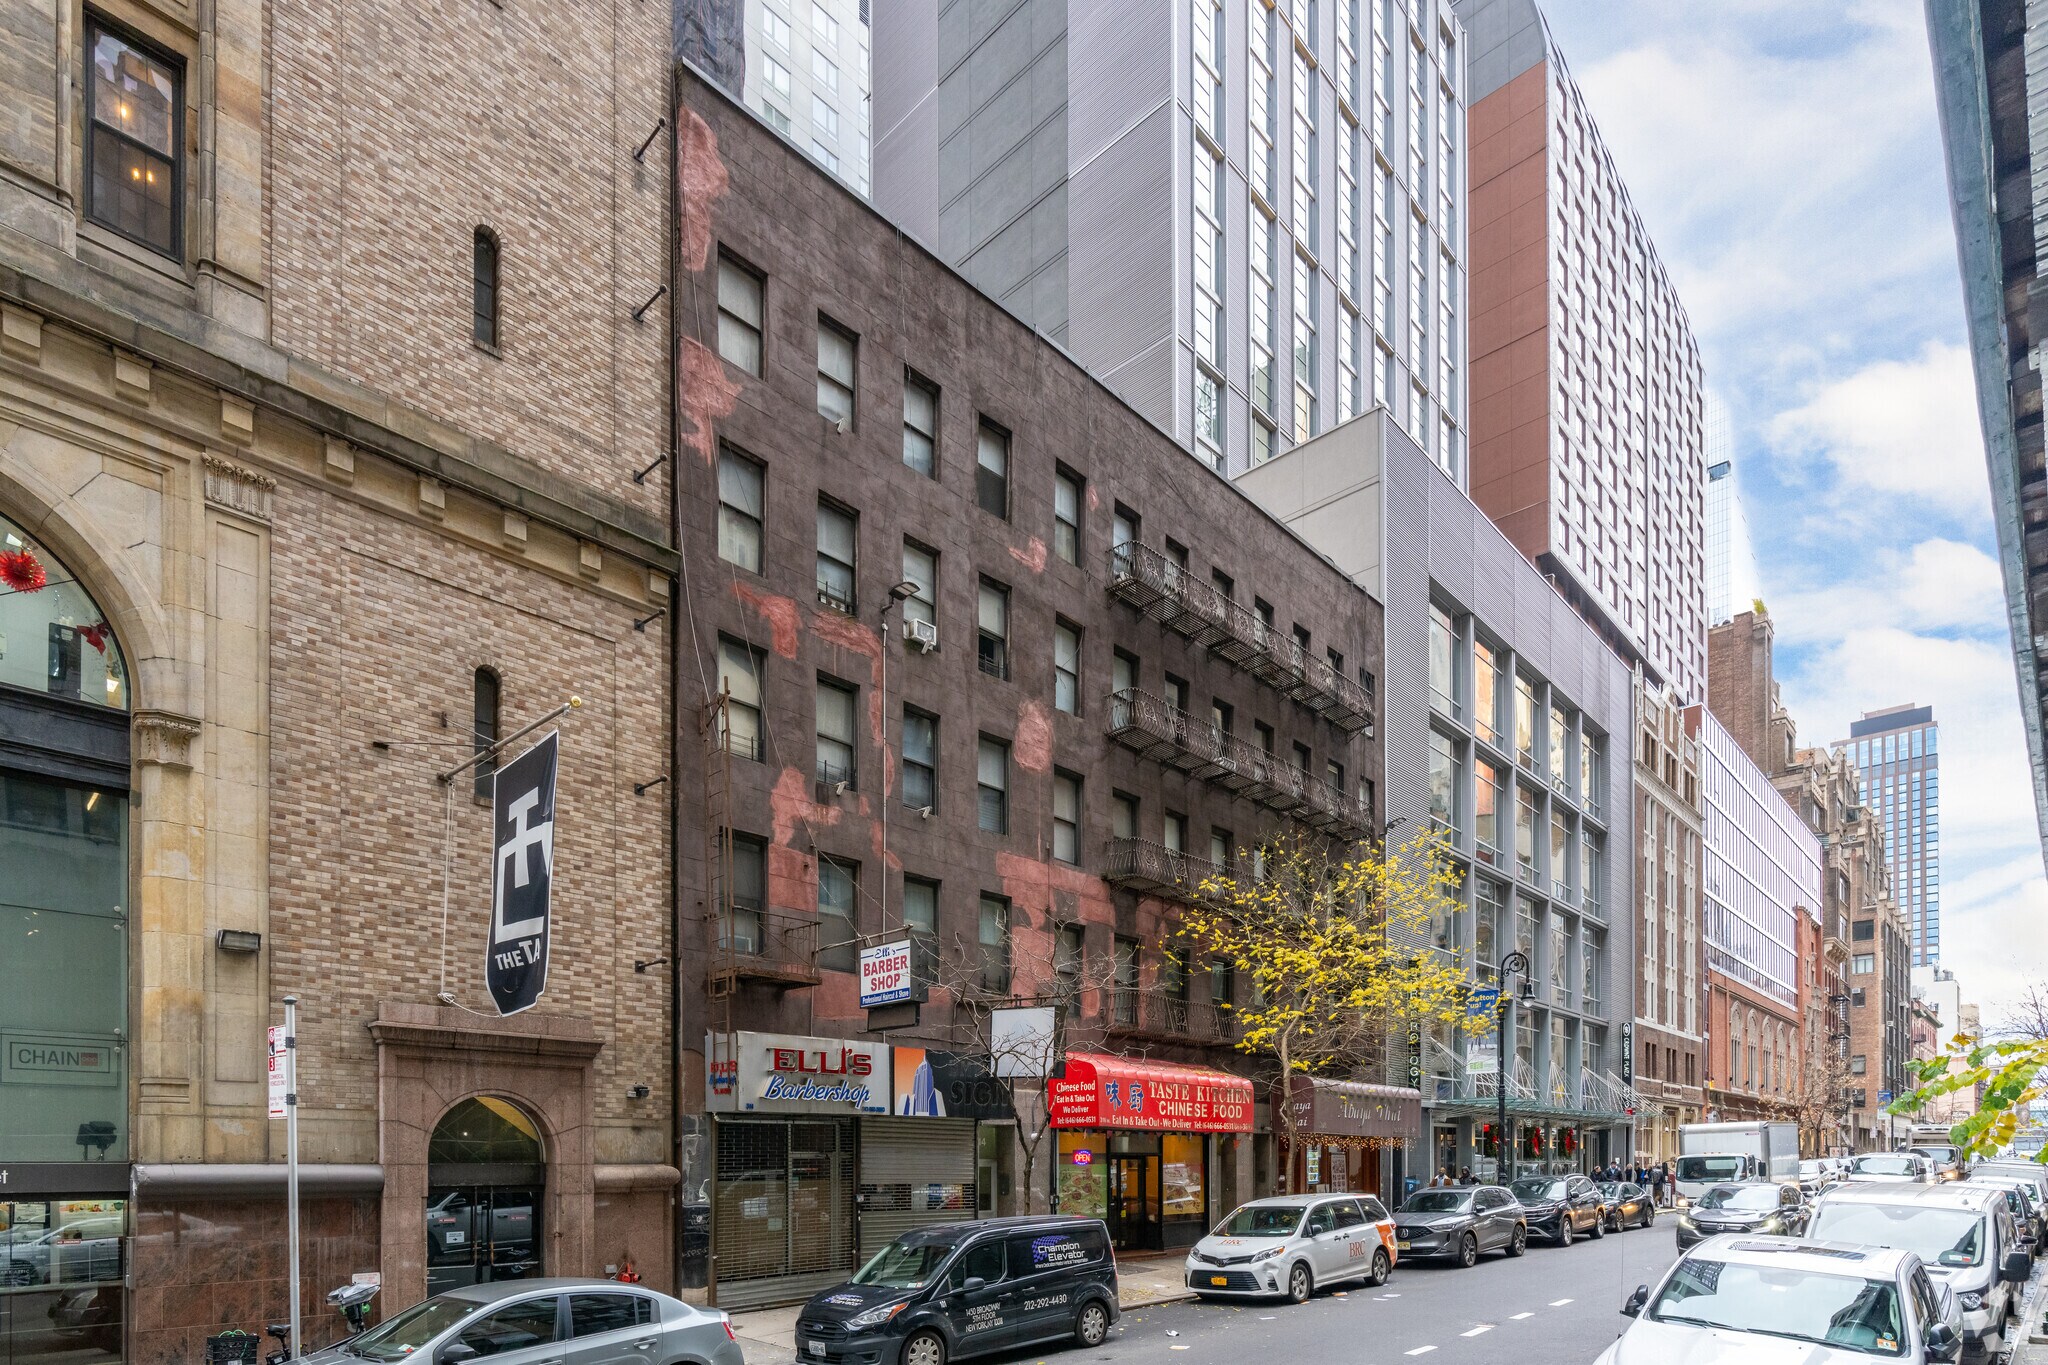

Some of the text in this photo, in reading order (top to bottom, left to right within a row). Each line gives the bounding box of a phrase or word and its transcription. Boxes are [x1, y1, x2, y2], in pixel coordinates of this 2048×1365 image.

[495, 947, 522, 970] THE
[864, 955, 908, 977] BARBER
[871, 974, 901, 992] SHOP
[862, 993, 882, 1004] Professional
[883, 992, 895, 1001] Haircut
[899, 990, 909, 998] Shave
[18, 1048, 80, 1066] CHAIN
[765, 1074, 871, 1109] Barbershop
[1056, 1080, 1096, 1093] Chinese Food
[1149, 1081, 1251, 1104] TASTE KITCHEN
[1056, 1095, 1065, 1104] Eat
[1065, 1095, 1070, 1103] In
[1074, 1095, 1085, 1103] Take
[1086, 1094, 1095, 1102] Out
[1063, 1105, 1089, 1114] We Deliver
[1159, 1101, 1243, 1118] CHINESE FOOD
[1112, 1115, 1121, 1124] Eat
[1122, 1116, 1128, 1125] In
[1129, 1116, 1134, 1125] &
[1135, 1116, 1148, 1126] Take
[1148, 1117, 1160, 1127] Out
[1162, 1118, 1171, 1127] We
[1172, 1118, 1192, 1128] Deliver
[1074, 1153, 1091, 1163] OPEN
[1037, 1242, 1080, 1254] Champion
[1349, 1240, 1366, 1258] BRC
[1047, 1250, 1086, 1262] Elevator
[965, 1302, 1001, 1317] 1450 BROADWAY
[1023, 1294, 1068, 1311] 212-292-4430
[972, 1311, 996, 1323] 5TH FLOOR
